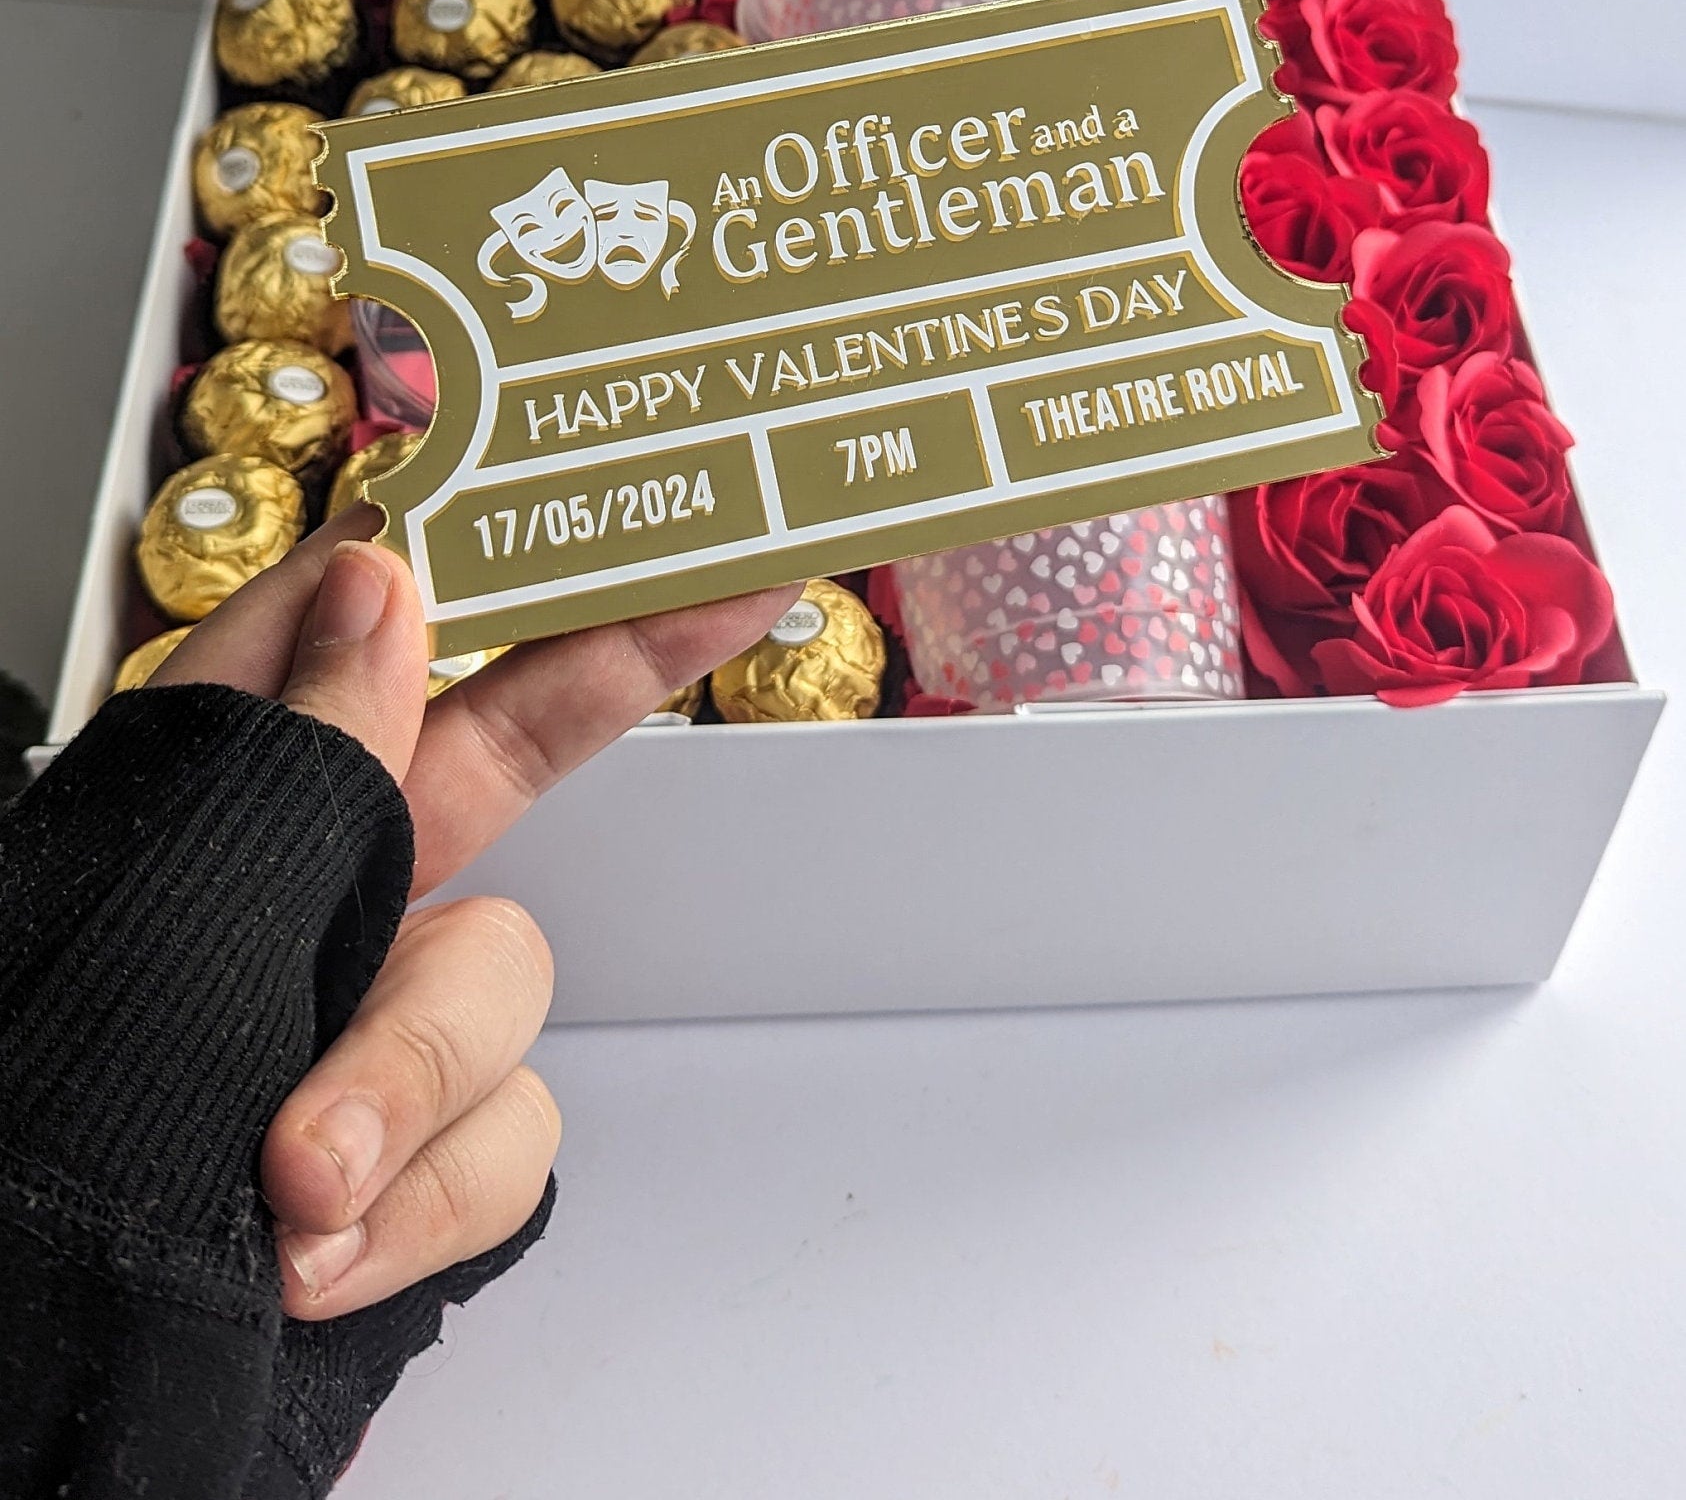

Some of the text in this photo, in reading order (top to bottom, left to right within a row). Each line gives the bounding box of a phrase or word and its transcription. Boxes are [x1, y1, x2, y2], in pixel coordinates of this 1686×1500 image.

[712, 104, 1140, 213] An Officer and a
[712, 148, 1168, 283] Gentleman
[524, 269, 1188, 444] HAPPY VALENTINES DAY
[1019, 350, 1304, 445] THEATRE ROYAL
[834, 425, 919, 487] 7PM
[473, 468, 716, 561] 17/05/2024
